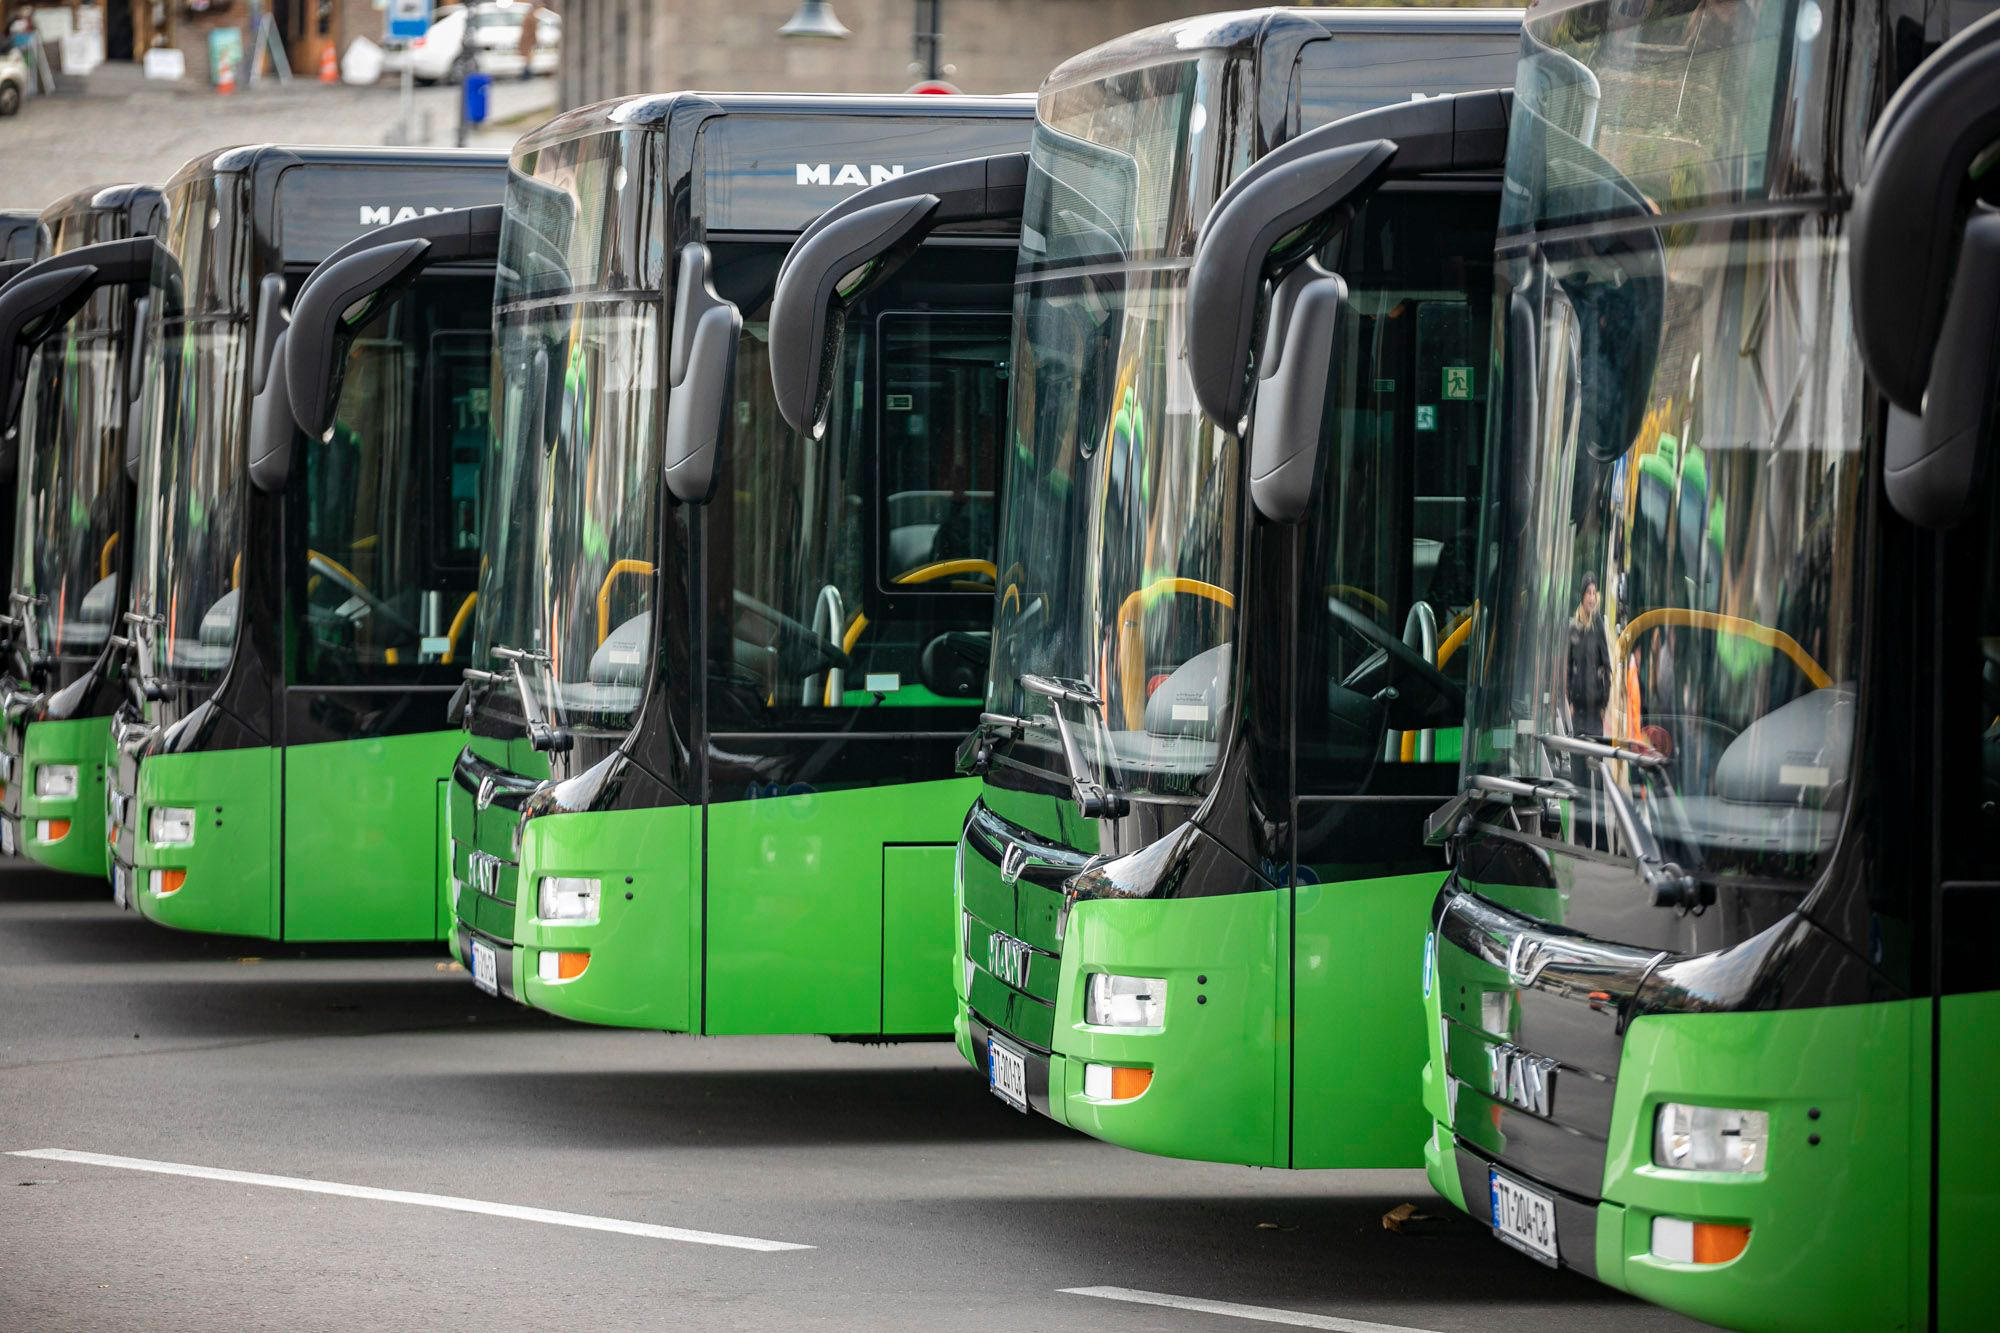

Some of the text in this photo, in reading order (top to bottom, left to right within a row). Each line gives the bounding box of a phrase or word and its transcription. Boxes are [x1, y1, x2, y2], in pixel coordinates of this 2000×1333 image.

[796, 163, 904, 185] MAN
[988, 931, 1029, 988] MAN
[1485, 1046, 1556, 1117] MAN
